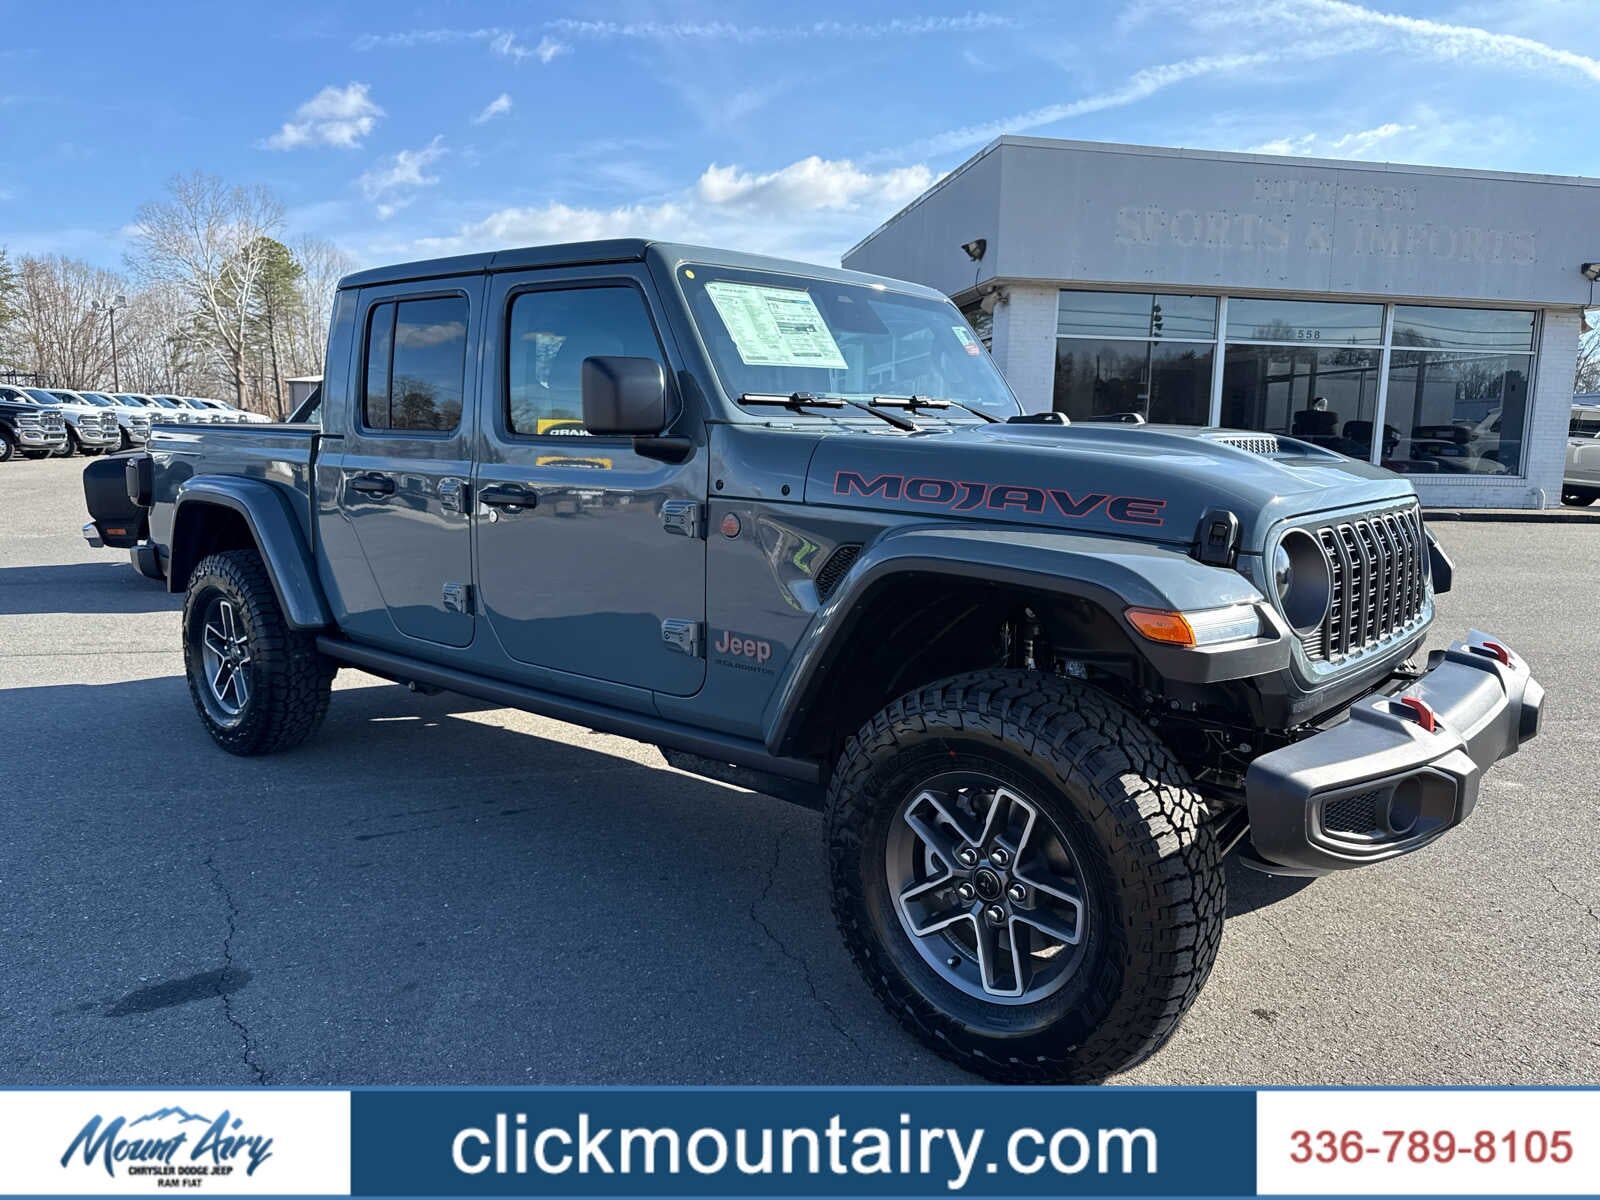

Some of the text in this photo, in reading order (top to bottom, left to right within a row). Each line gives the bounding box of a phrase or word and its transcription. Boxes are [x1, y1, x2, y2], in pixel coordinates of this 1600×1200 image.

[1297, 329, 1320, 339] 558
[834, 471, 1167, 526] MOJAVE
[715, 631, 771, 663] Jeep
